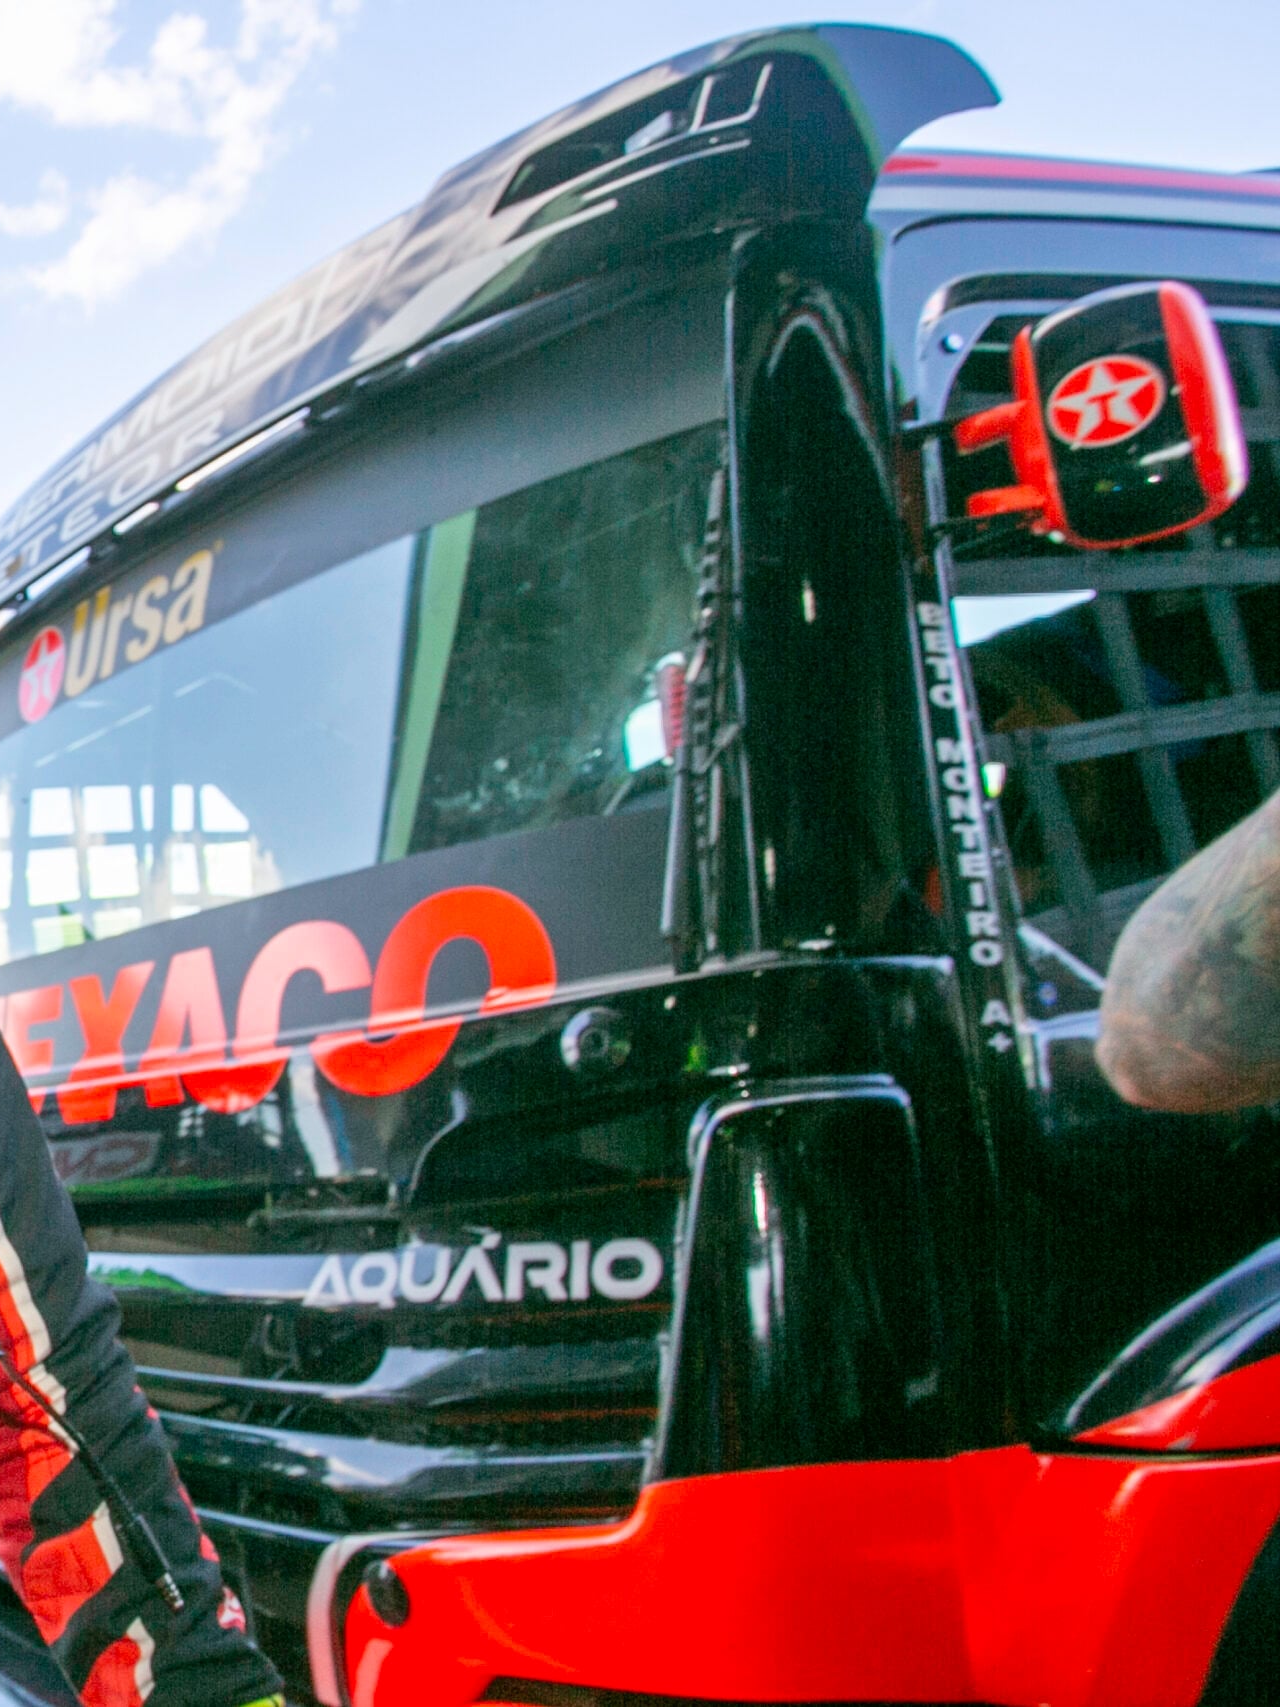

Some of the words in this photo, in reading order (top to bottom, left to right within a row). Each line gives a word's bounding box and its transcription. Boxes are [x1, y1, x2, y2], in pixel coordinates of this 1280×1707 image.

[64, 548, 213, 698] Ursa
[936, 737, 1002, 967] MONTEIRO
[302, 1230, 663, 1309] AQUÁRIO
